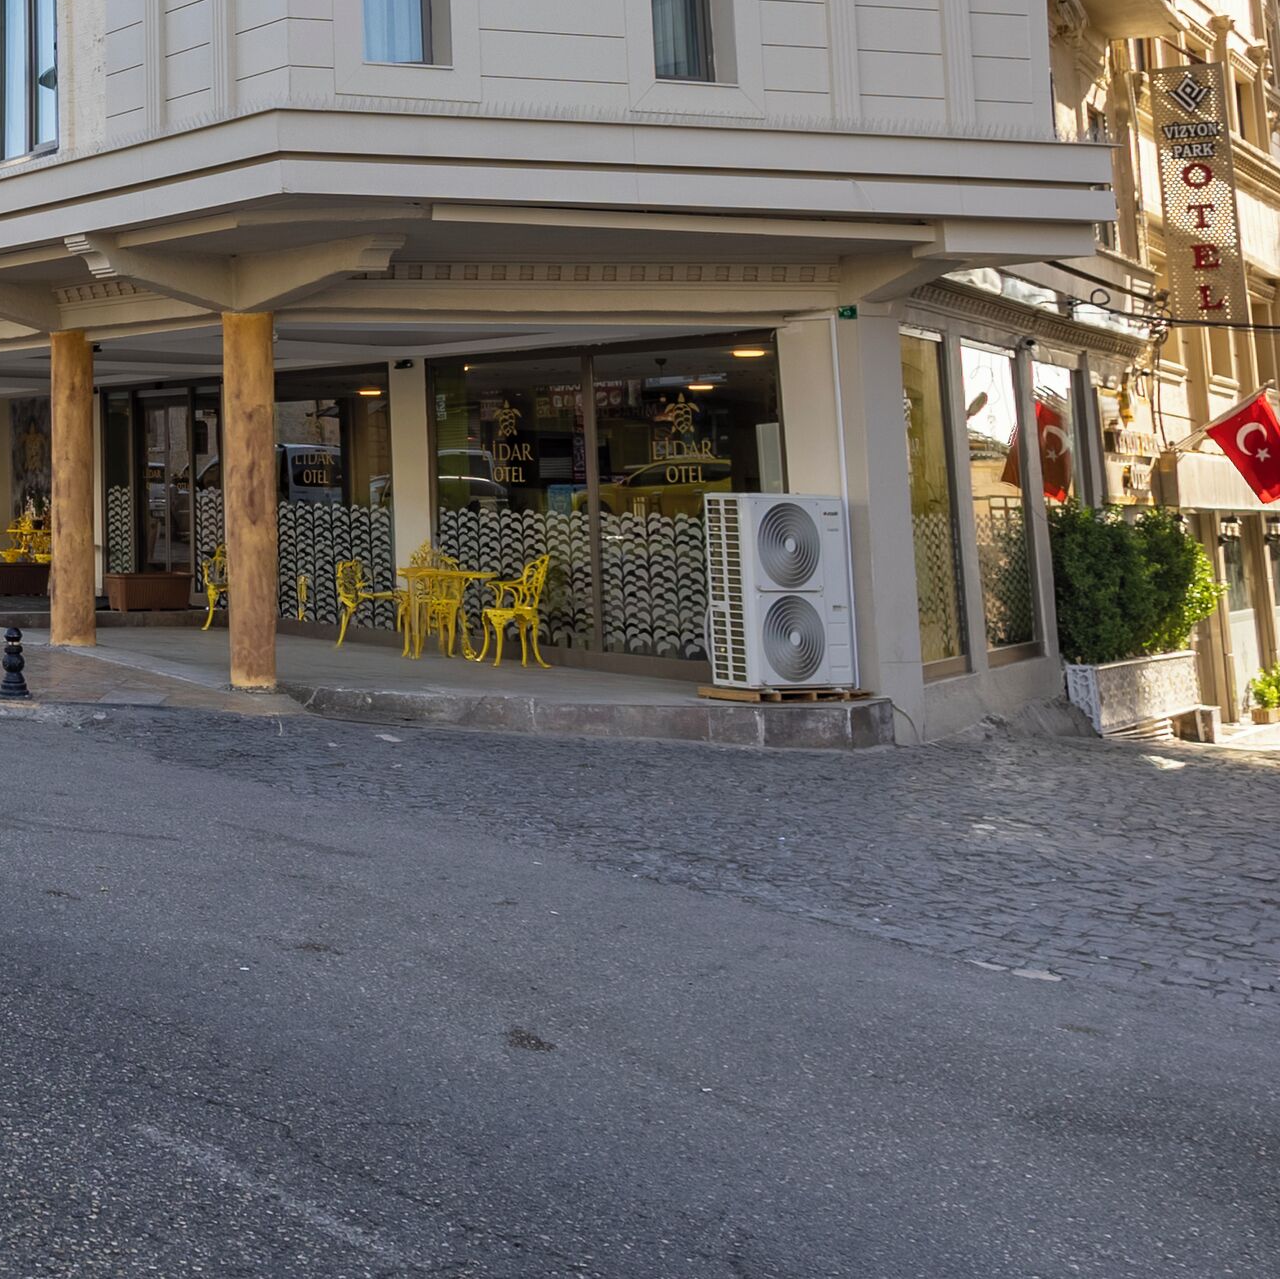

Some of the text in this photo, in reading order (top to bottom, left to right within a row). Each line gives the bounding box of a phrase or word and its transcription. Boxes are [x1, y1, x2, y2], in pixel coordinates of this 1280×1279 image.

[1164, 122, 1218, 139] VİZYON
[1173, 143, 1214, 158] PARK
[1183, 163, 1225, 310] OTEL
[481, 441, 534, 461] LİDAR
[652, 437, 717, 460] LİDAR
[303, 469, 329, 484] OTEL
[493, 466, 526, 482] OTEL
[666, 465, 706, 483] OTEL
